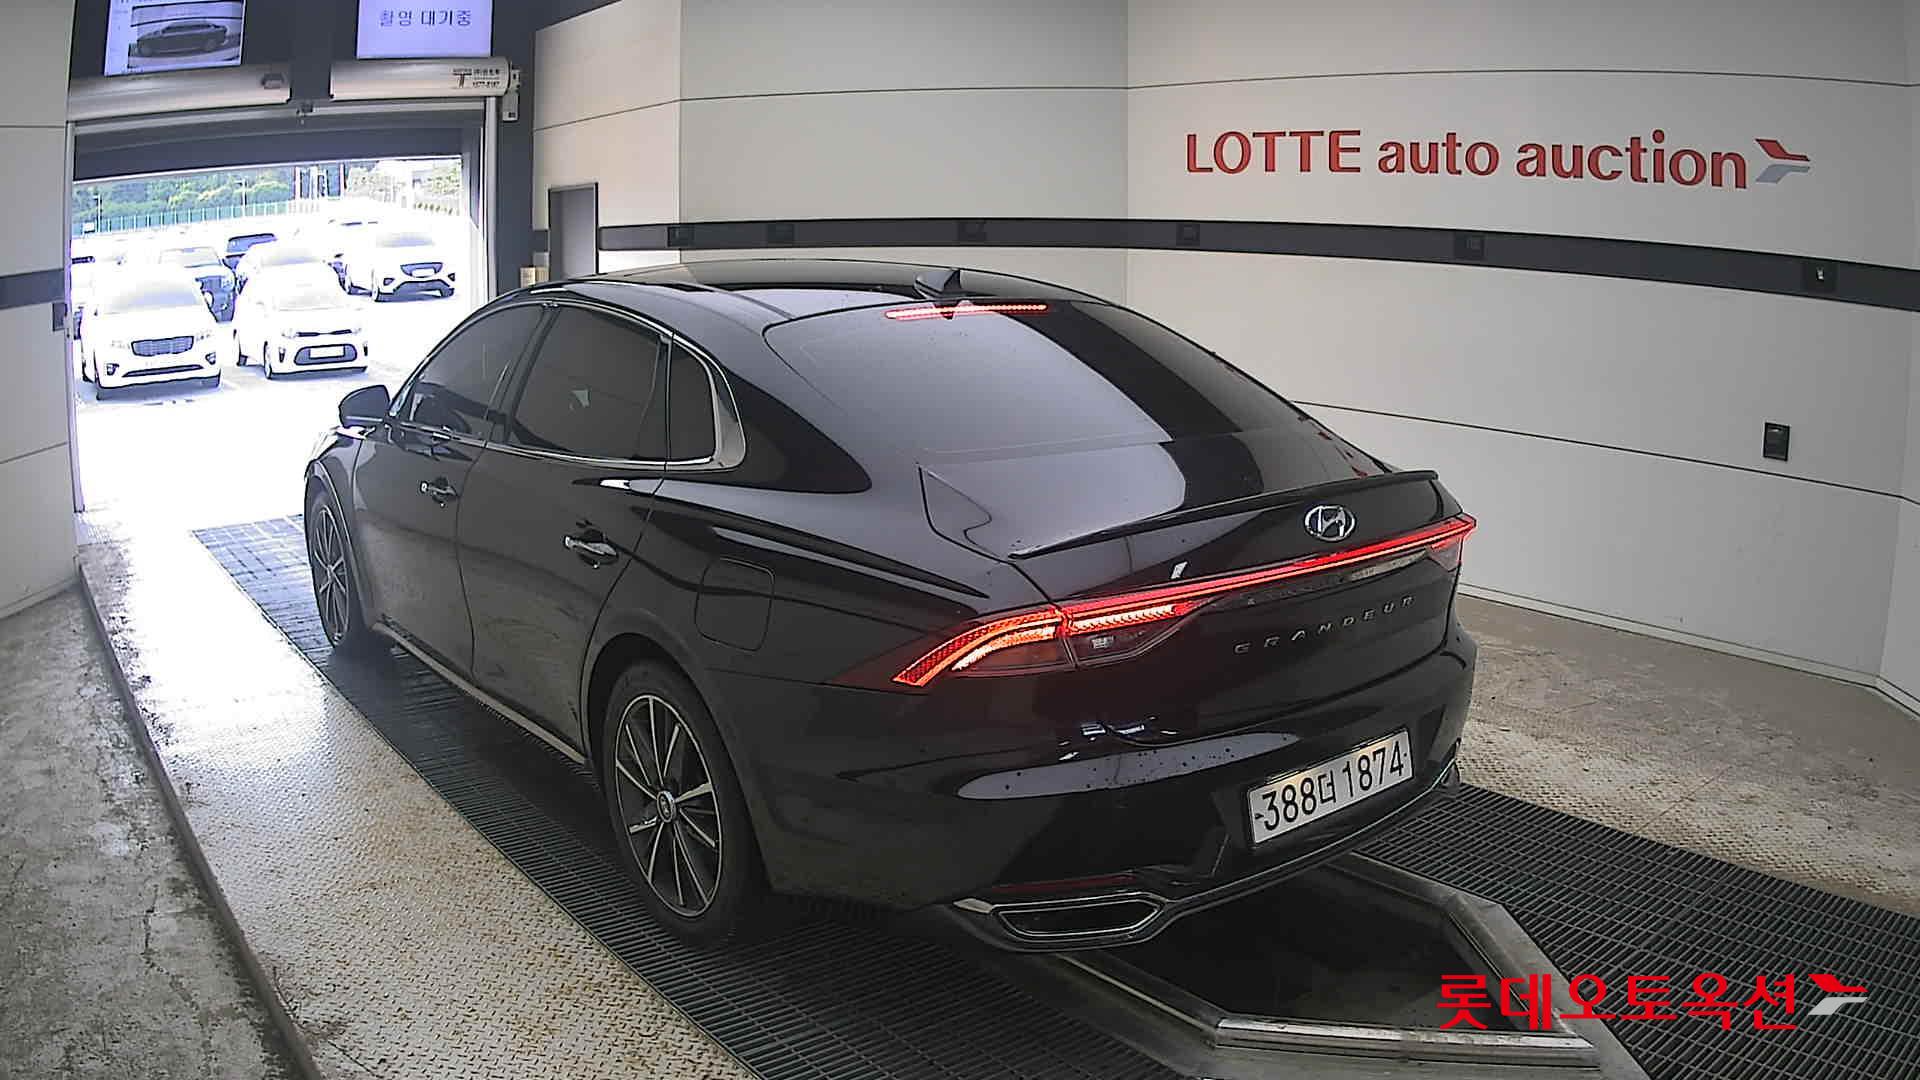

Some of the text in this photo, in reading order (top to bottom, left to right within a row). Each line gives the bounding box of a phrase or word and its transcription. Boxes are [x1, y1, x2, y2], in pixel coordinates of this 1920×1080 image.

[1186, 129, 1748, 188] LOTTE auto auction
[1234, 595, 1416, 654] GRANDEUR
[1261, 740, 1404, 831] 388더 1874
